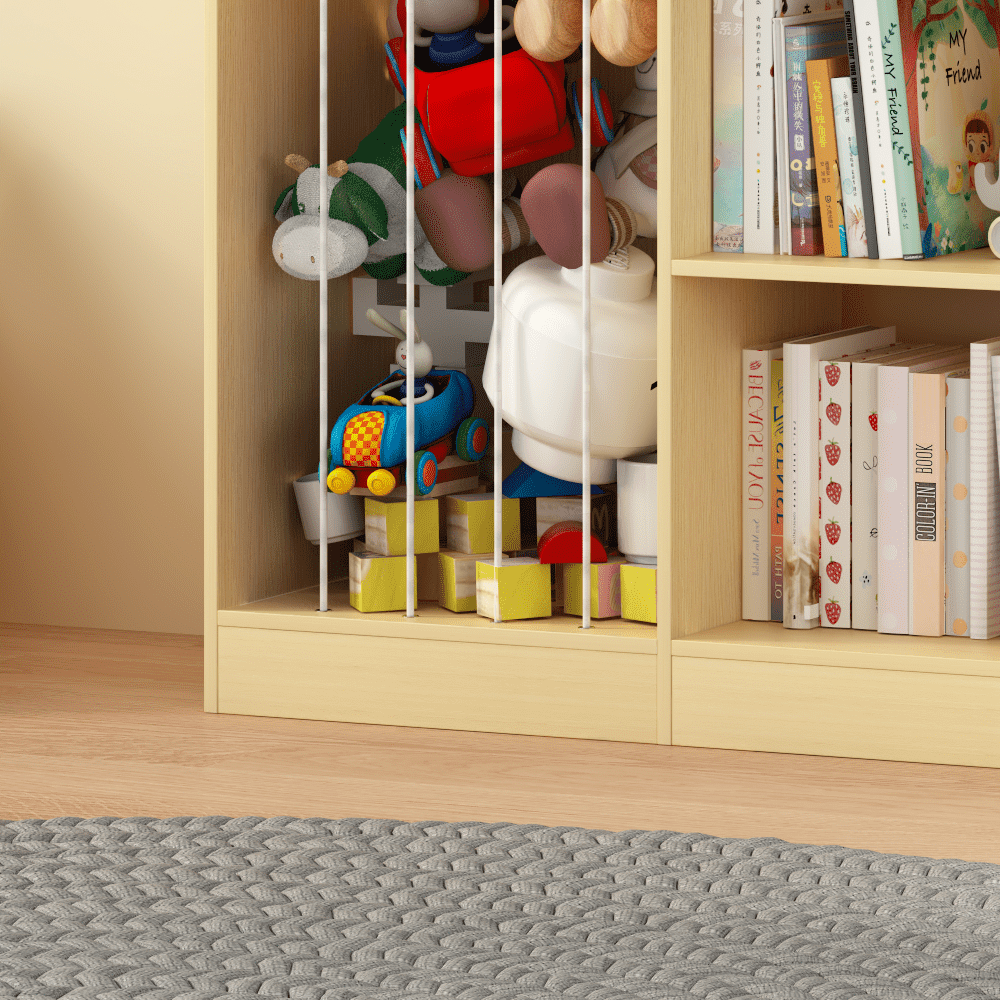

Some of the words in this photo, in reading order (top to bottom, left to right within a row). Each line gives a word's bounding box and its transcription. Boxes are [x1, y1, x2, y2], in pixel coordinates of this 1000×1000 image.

[949, 28, 967, 55] MY
[884, 53, 896, 79] MY
[945, 58, 982, 86] Friend
[887, 88, 903, 137] Friend
[915, 443, 933, 474] BOOK
